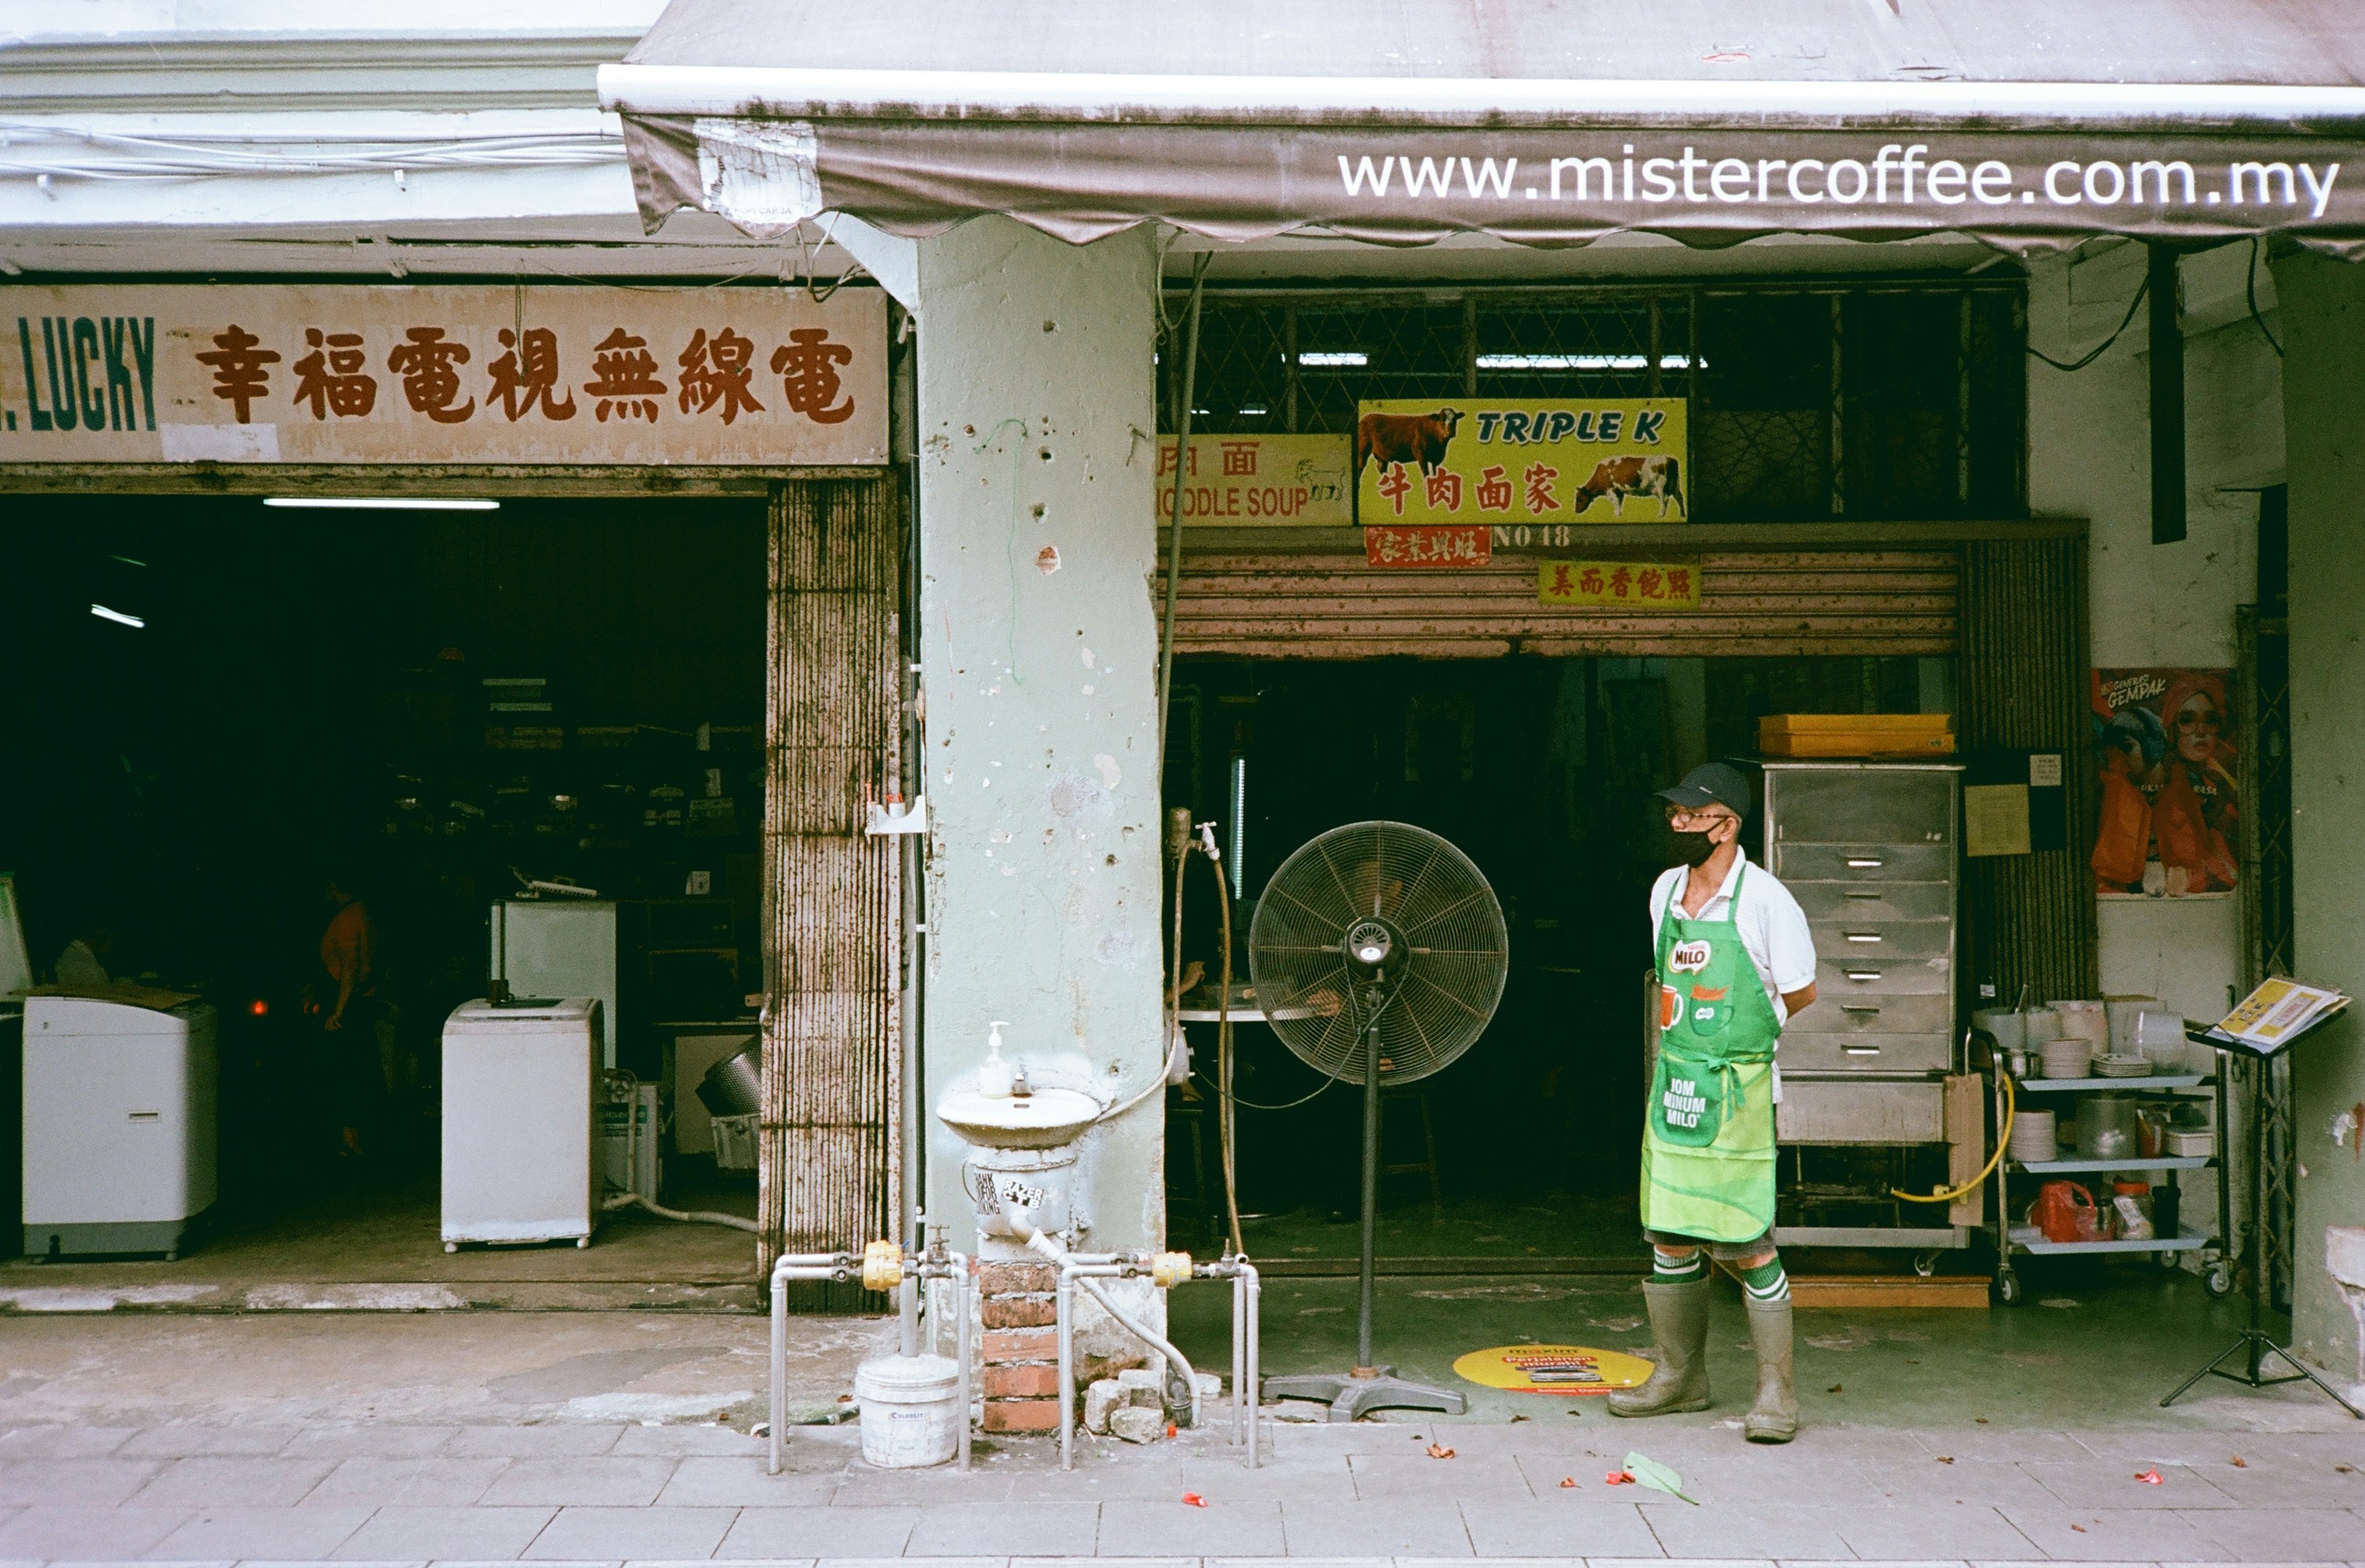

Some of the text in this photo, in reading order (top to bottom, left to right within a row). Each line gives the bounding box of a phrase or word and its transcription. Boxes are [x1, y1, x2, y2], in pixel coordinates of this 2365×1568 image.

[1337, 144, 2341, 219] www.mistercoffee.com.my
[17, 316, 157, 432] LUCKY
[194, 323, 855, 425] 幸福電視無線電
[1477, 411, 1665, 444] TRIPLE K
[1157, 486, 1309, 517] OODLE SOUP
[1378, 462, 1562, 515] 牛肉面家
[1376, 529, 1478, 562] 家業興旺
[2107, 678, 2166, 708] GEMPAK
[1675, 949, 1705, 965] MILO
[1663, 1090, 1706, 1113] MINUM
[1670, 1078, 1695, 1097] JOM
[1666, 1108, 1698, 1128] MILO
[1003, 1190, 1040, 1210] CTB
[1004, 1179, 1043, 1201] RAZER
